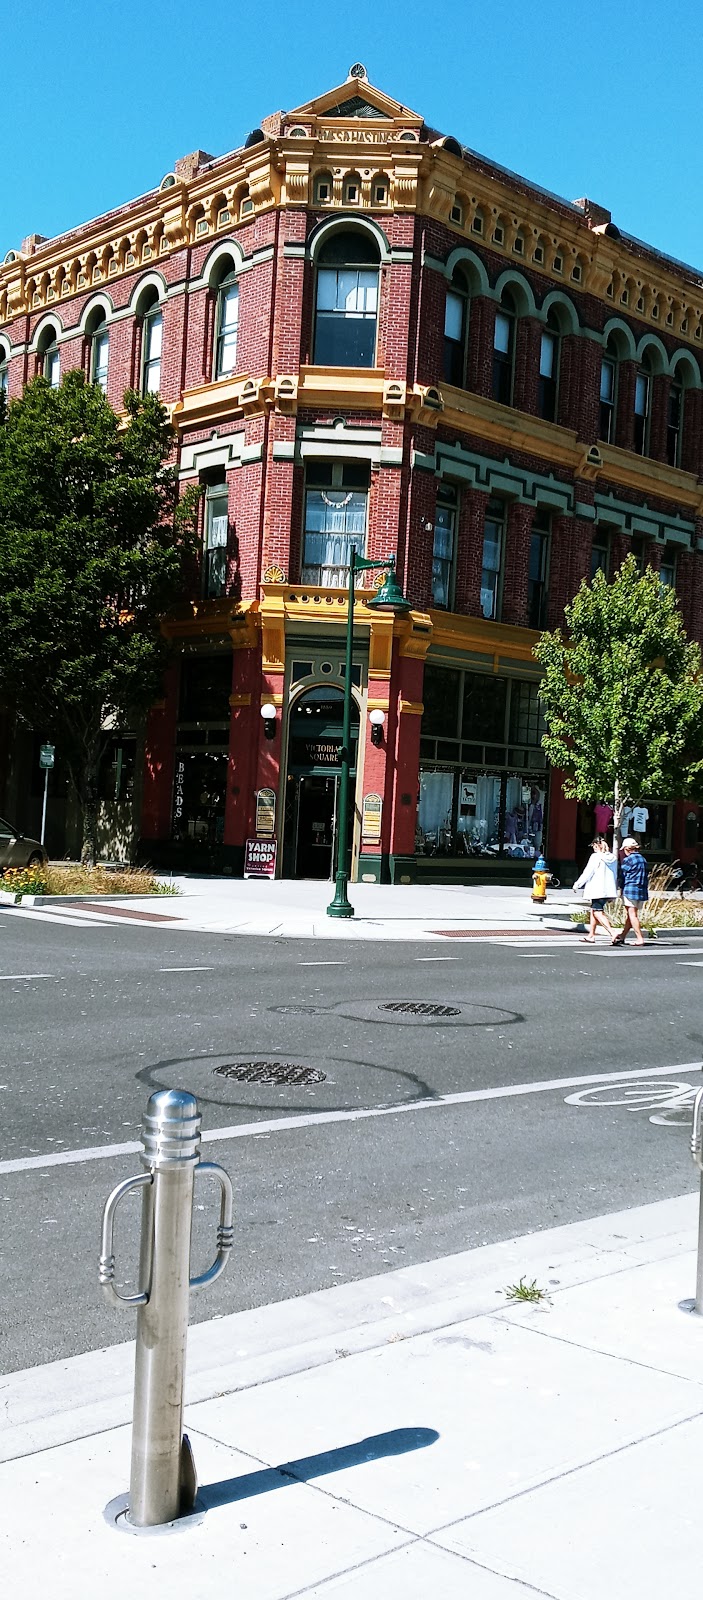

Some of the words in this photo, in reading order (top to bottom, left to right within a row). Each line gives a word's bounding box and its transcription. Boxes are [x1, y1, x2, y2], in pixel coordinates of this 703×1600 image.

[305, 744, 339, 753] VICTORIA
[309, 753, 339, 762] SQUARE
[176, 762, 185, 817] BEADS
[248, 842, 275, 853] YARN
[248, 852, 273, 863] SHOP
